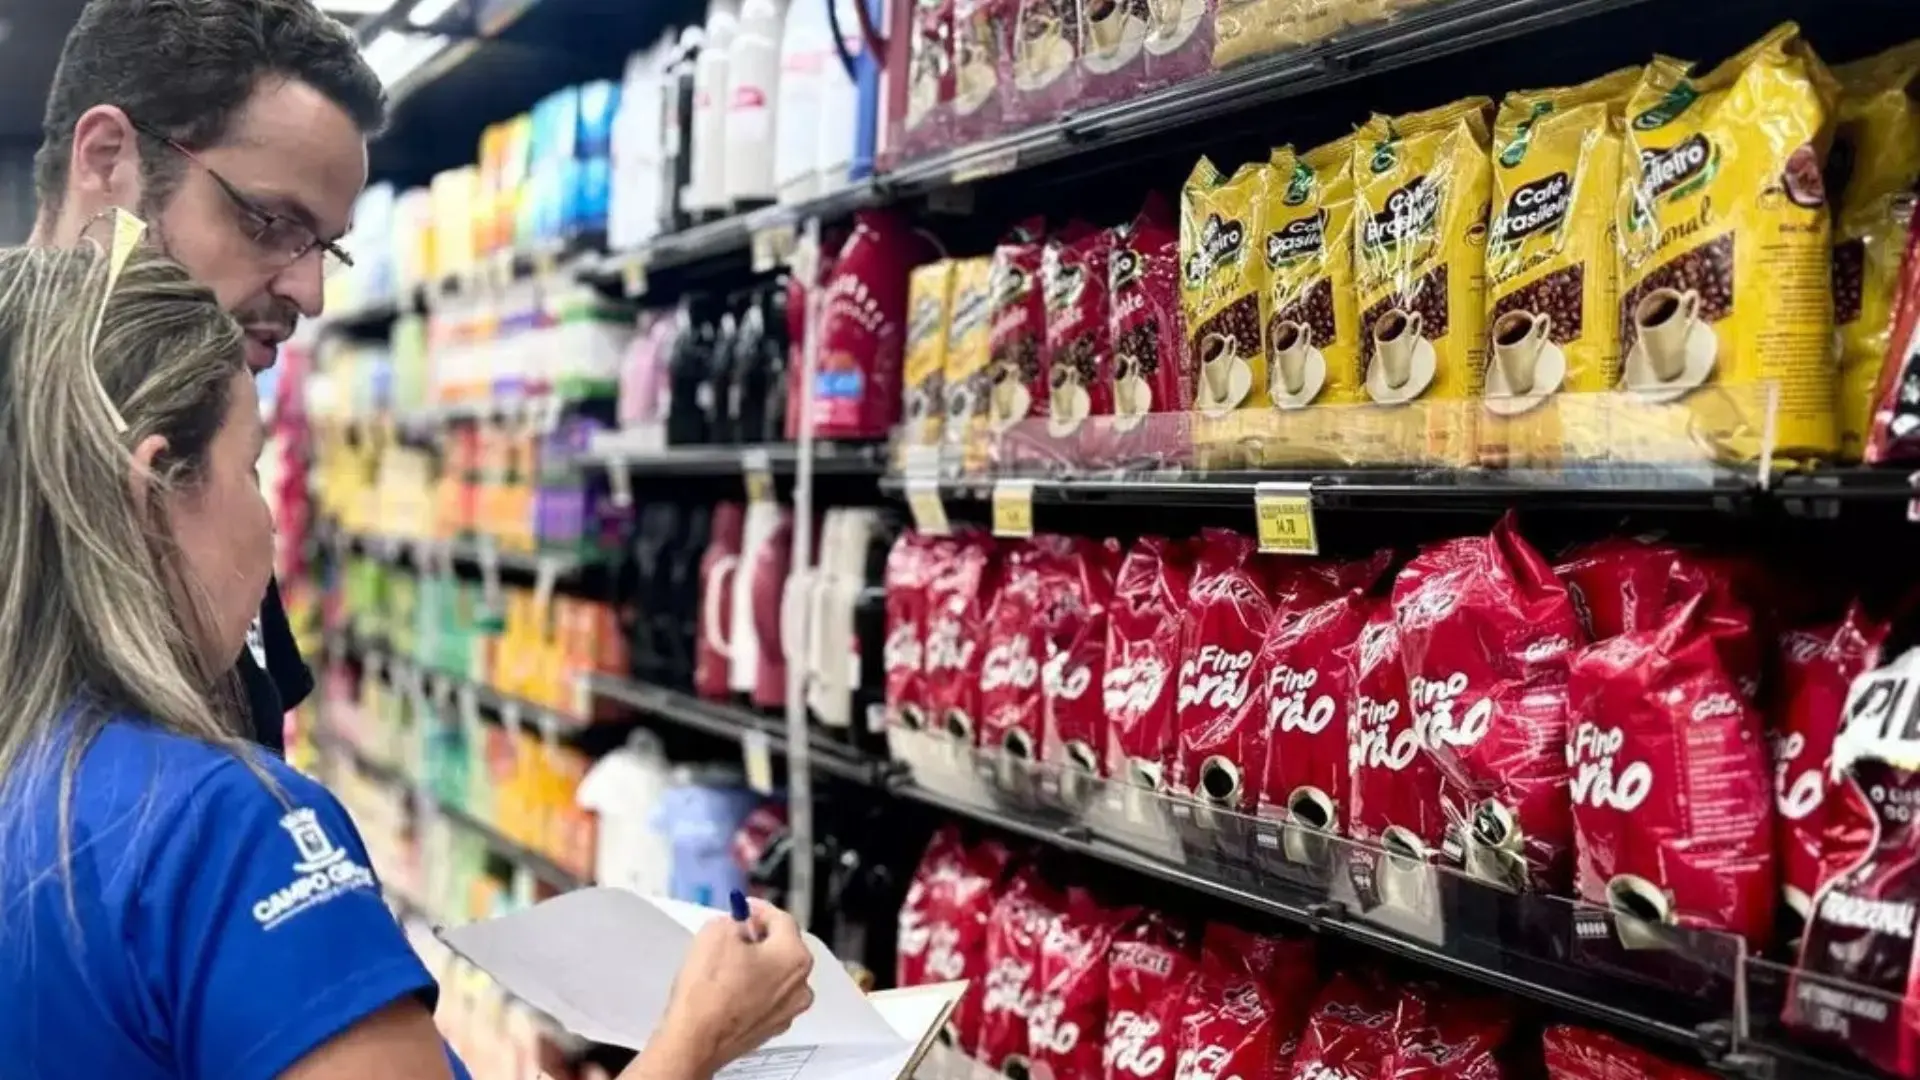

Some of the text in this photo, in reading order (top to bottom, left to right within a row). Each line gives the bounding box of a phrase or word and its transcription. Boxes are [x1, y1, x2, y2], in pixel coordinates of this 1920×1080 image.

[1514, 176, 1565, 207] Café
[1196, 645, 1253, 675] Fino
[1267, 664, 1319, 698] Fino
[1266, 690, 1337, 736] rão
[1357, 695, 1400, 730] Fino
[1414, 697, 1493, 750] rão
[1575, 720, 1624, 763] Fino
[1568, 752, 1653, 813] rão
[252, 870, 331, 923] CAMPO
